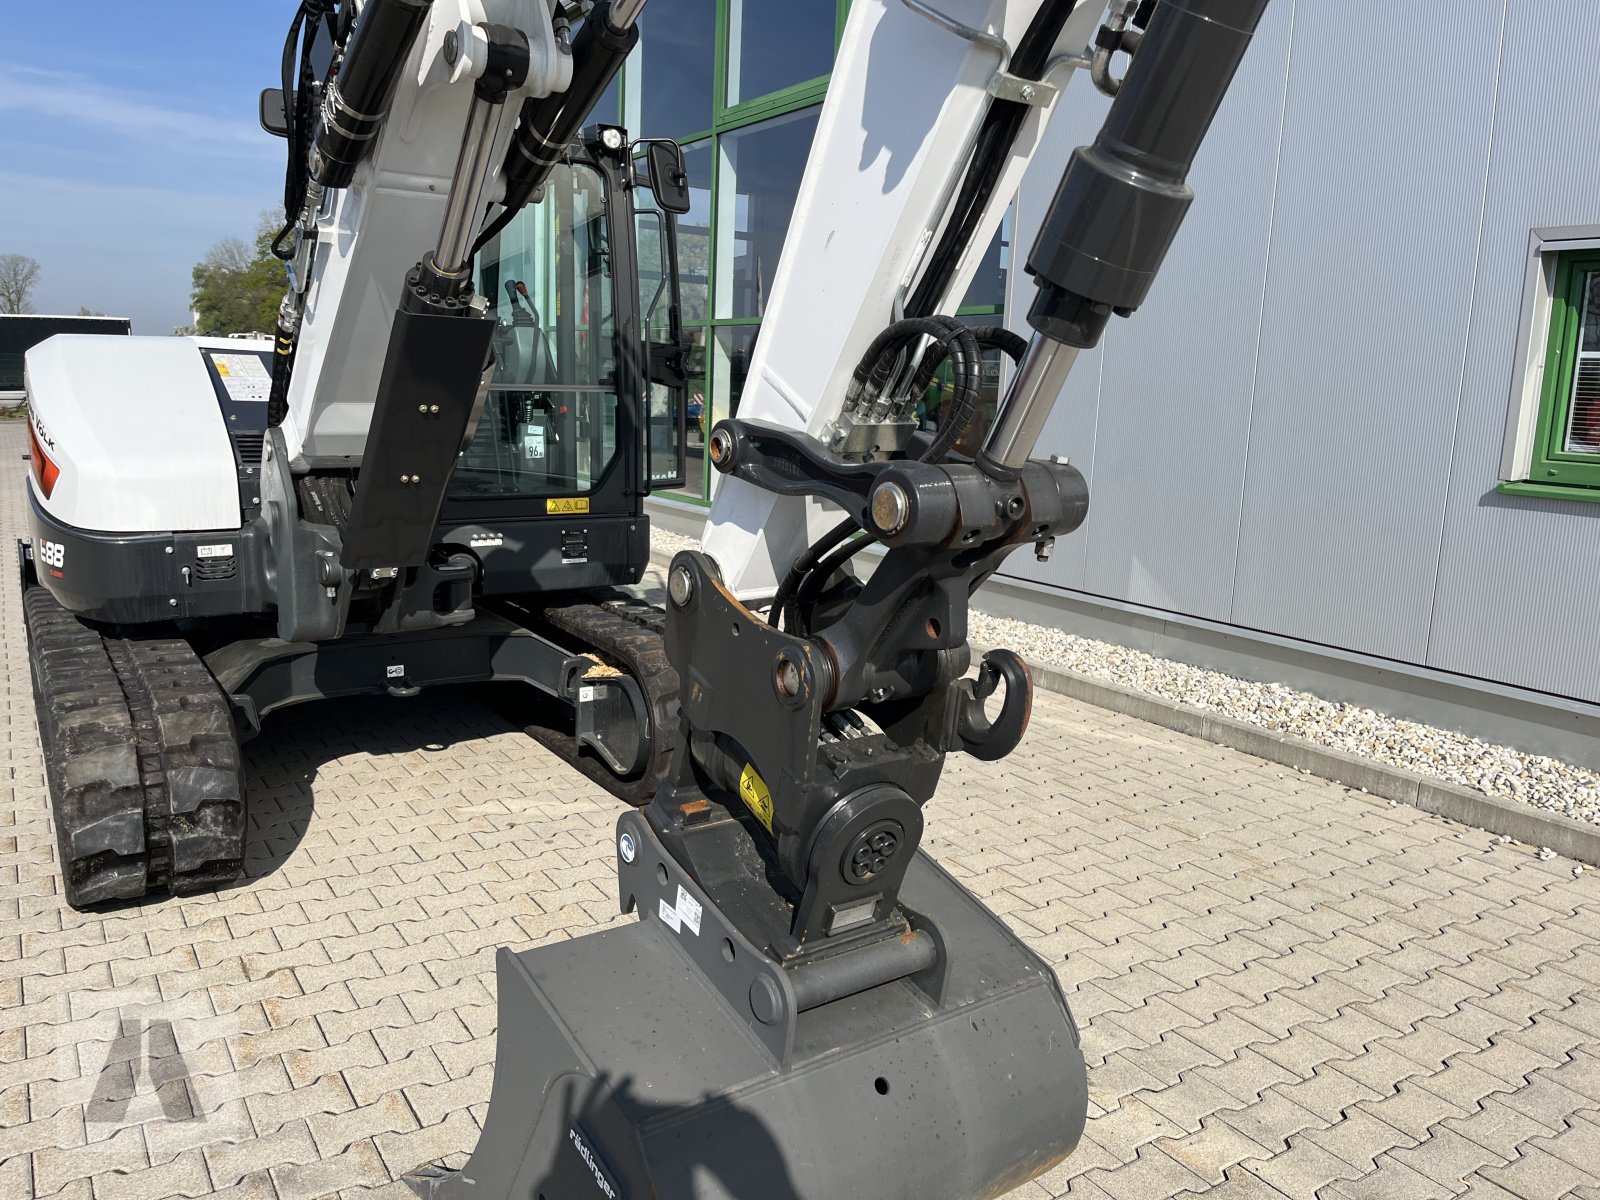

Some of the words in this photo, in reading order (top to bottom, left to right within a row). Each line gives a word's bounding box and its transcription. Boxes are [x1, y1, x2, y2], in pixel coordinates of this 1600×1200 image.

[36, 414, 55, 452] VÖLK
[529, 446, 538, 457] 96
[569, 1128, 616, 1200] rädlinger
